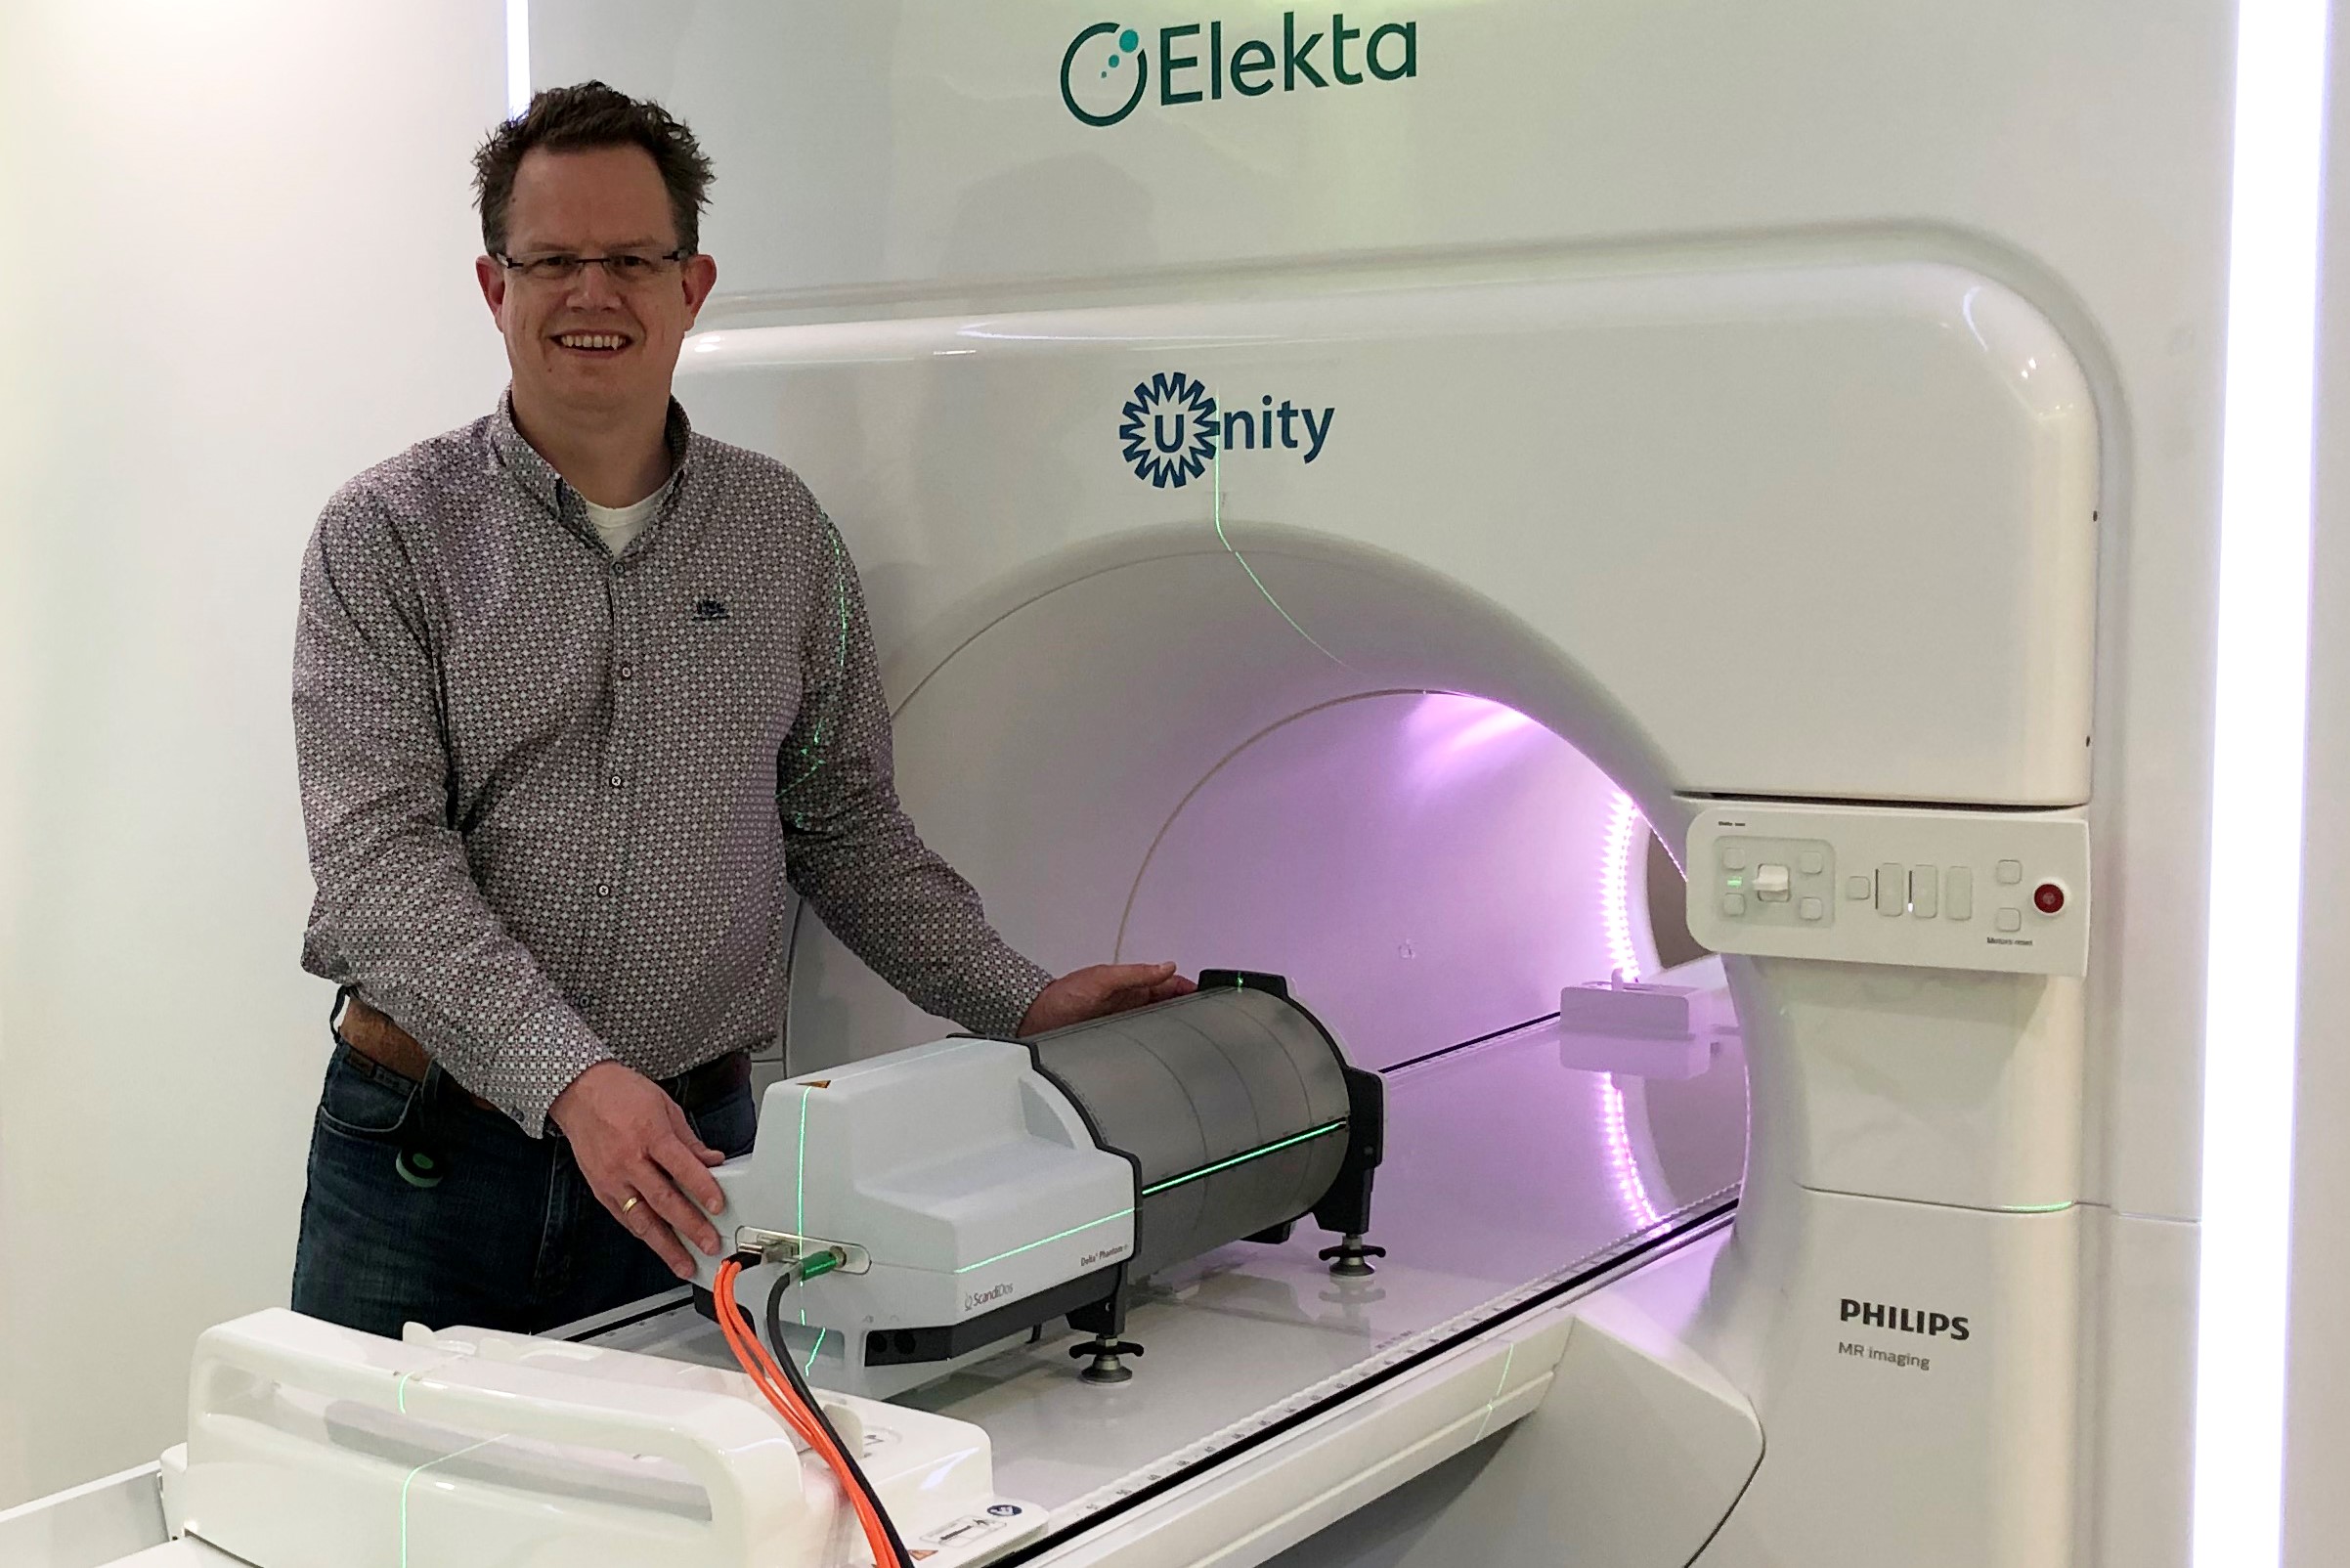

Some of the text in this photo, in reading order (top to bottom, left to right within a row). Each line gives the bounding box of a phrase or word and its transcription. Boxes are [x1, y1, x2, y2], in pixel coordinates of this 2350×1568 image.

[1159, 12, 1417, 106] Elekta
[1840, 1298, 1971, 1341] PHILIPS
[1839, 1341, 1931, 1371] MR imaging
